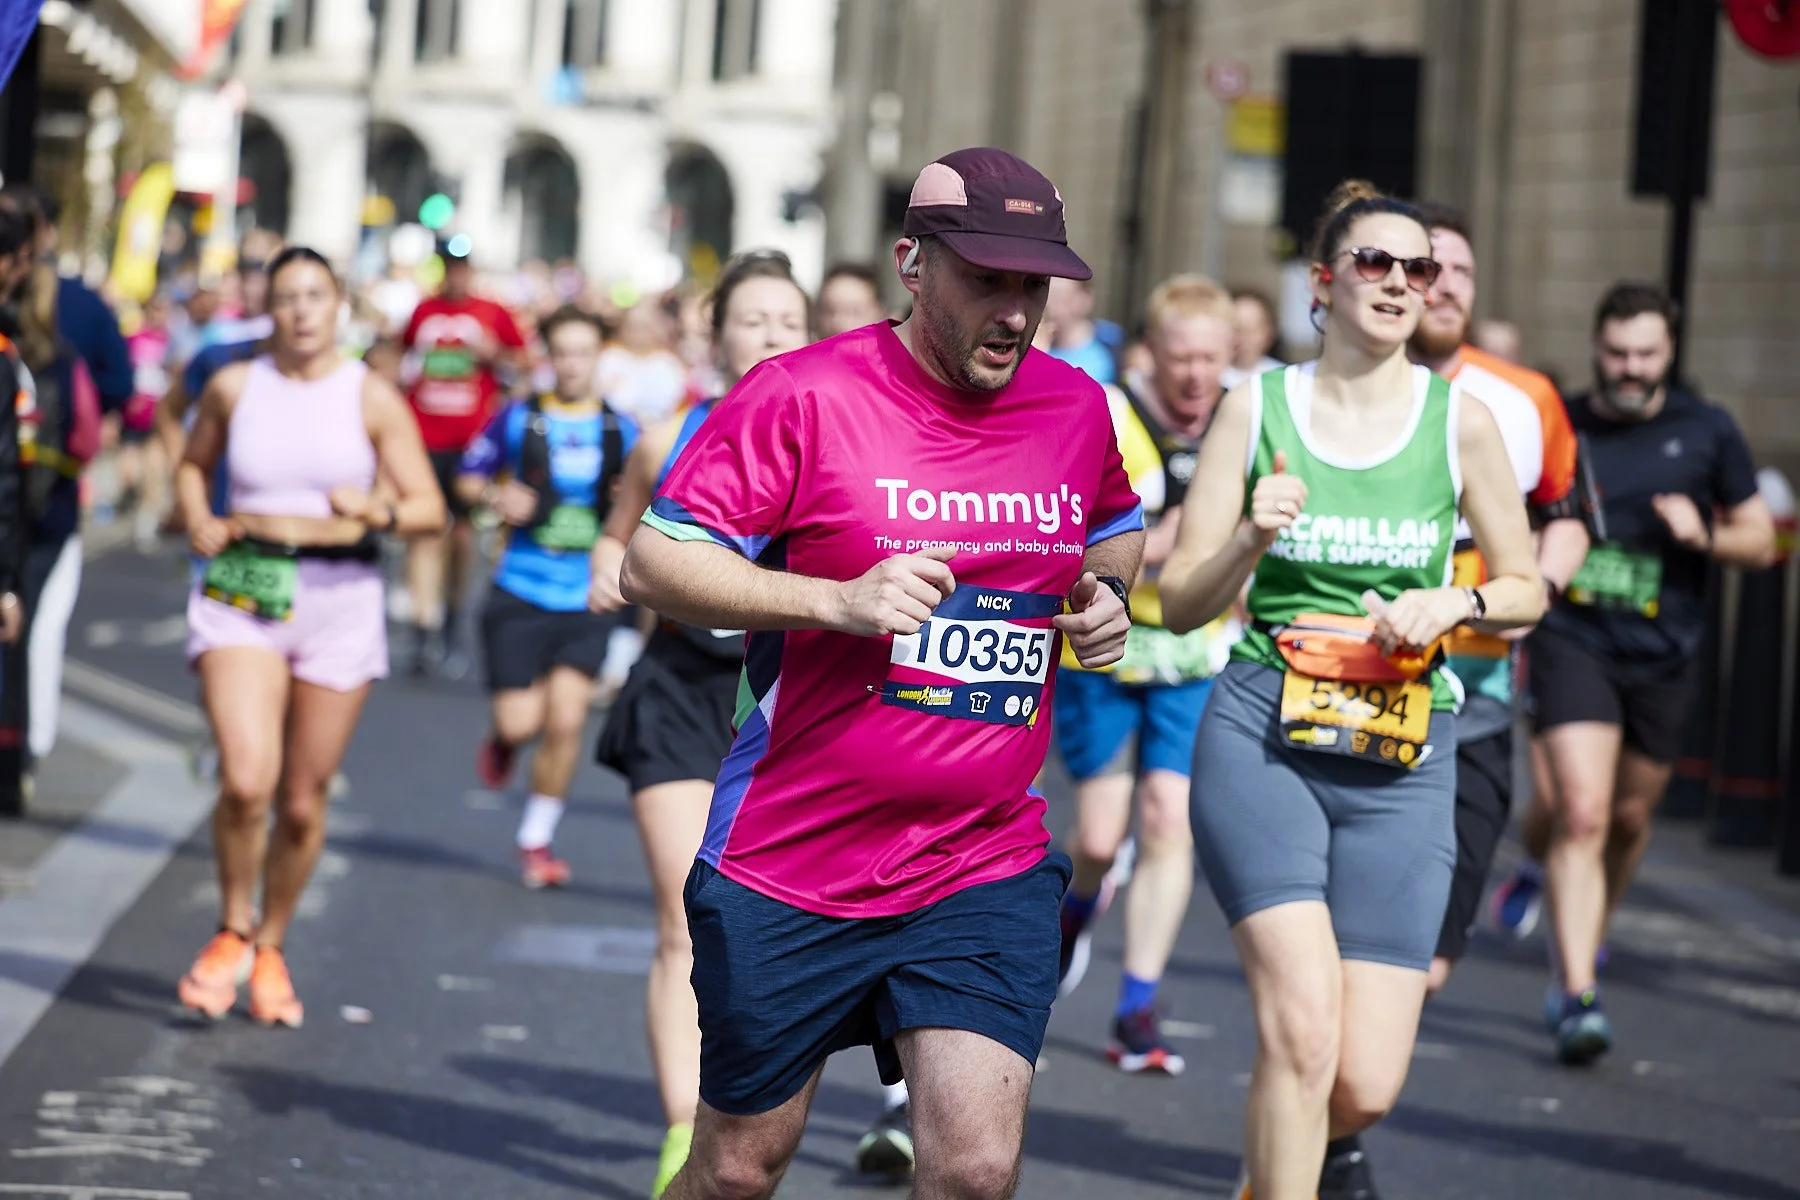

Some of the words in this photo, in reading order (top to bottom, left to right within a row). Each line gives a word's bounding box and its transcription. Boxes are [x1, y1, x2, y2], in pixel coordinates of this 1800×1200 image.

[875, 478, 1083, 534] Tommy's
[874, 535, 902, 550] The
[984, 539, 1012, 552] and
[1015, 539, 1049, 555] baby
[1052, 540, 1083, 557] charity
[1279, 513, 1439, 548] CMILLAN
[1267, 541, 1323, 563] NCER
[1328, 544, 1432, 568] SUPPORT
[976, 594, 1012, 611] NICK
[917, 620, 1046, 677] 10355
